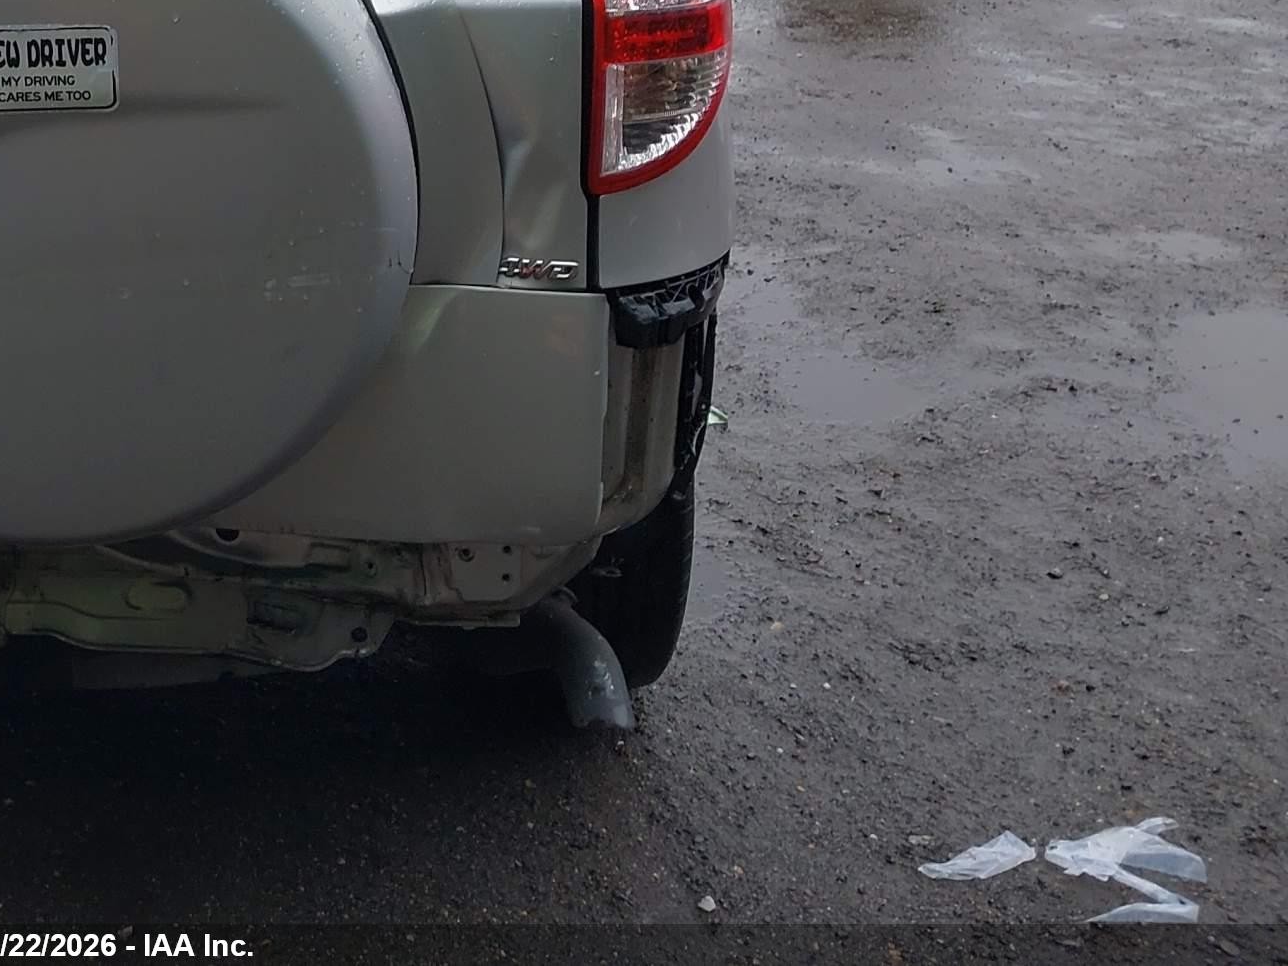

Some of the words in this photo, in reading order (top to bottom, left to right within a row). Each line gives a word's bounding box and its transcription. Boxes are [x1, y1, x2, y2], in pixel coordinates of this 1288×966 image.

[27, 36, 107, 68] DRIVER
[1, 76, 21, 87] MY
[24, 74, 76, 87] DRIVING
[44, 90, 63, 102] ME
[63, 90, 91, 101] TOO
